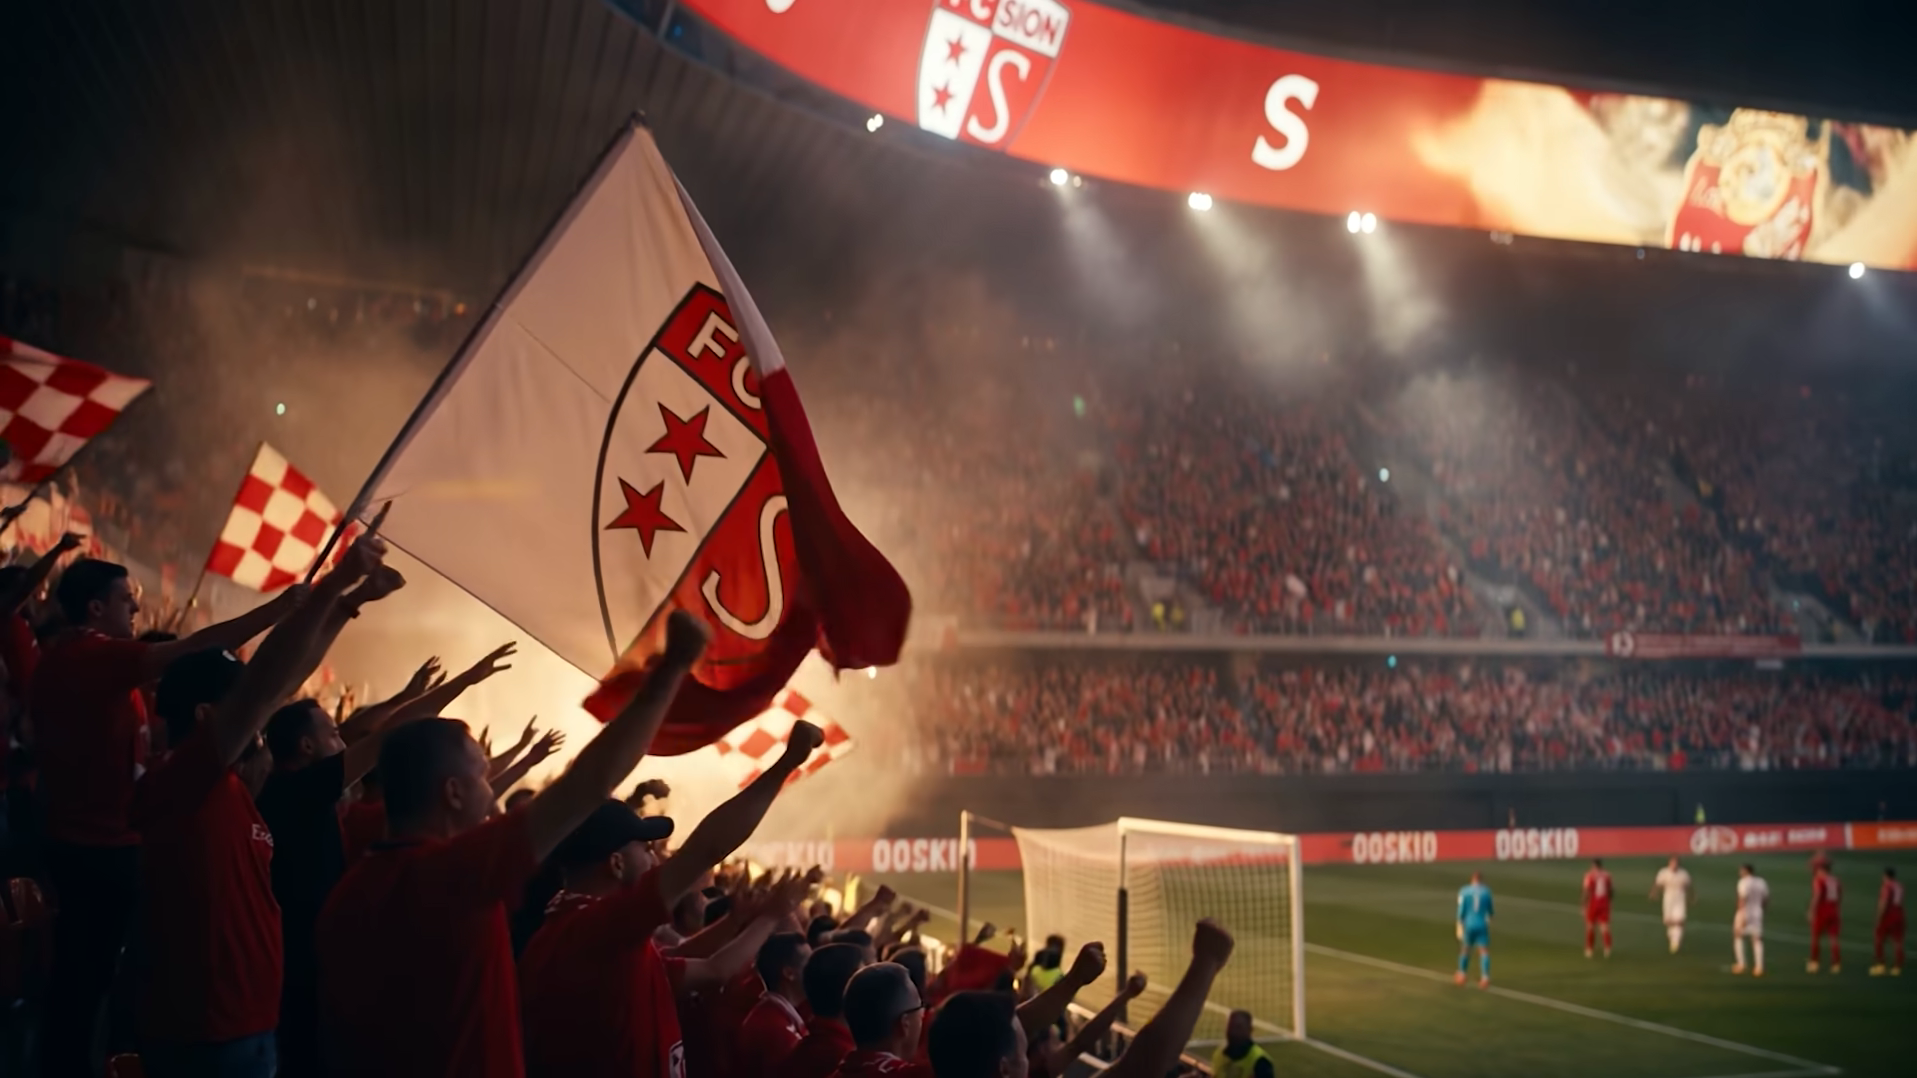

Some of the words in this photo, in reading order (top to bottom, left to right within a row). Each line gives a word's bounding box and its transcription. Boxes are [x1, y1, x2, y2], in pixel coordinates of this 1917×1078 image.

[949, 0, 994, 20] C
[1000, 0, 1060, 45] SION
[967, 50, 1030, 142] S
[1251, 74, 1319, 170] S
[702, 495, 788, 640] S
